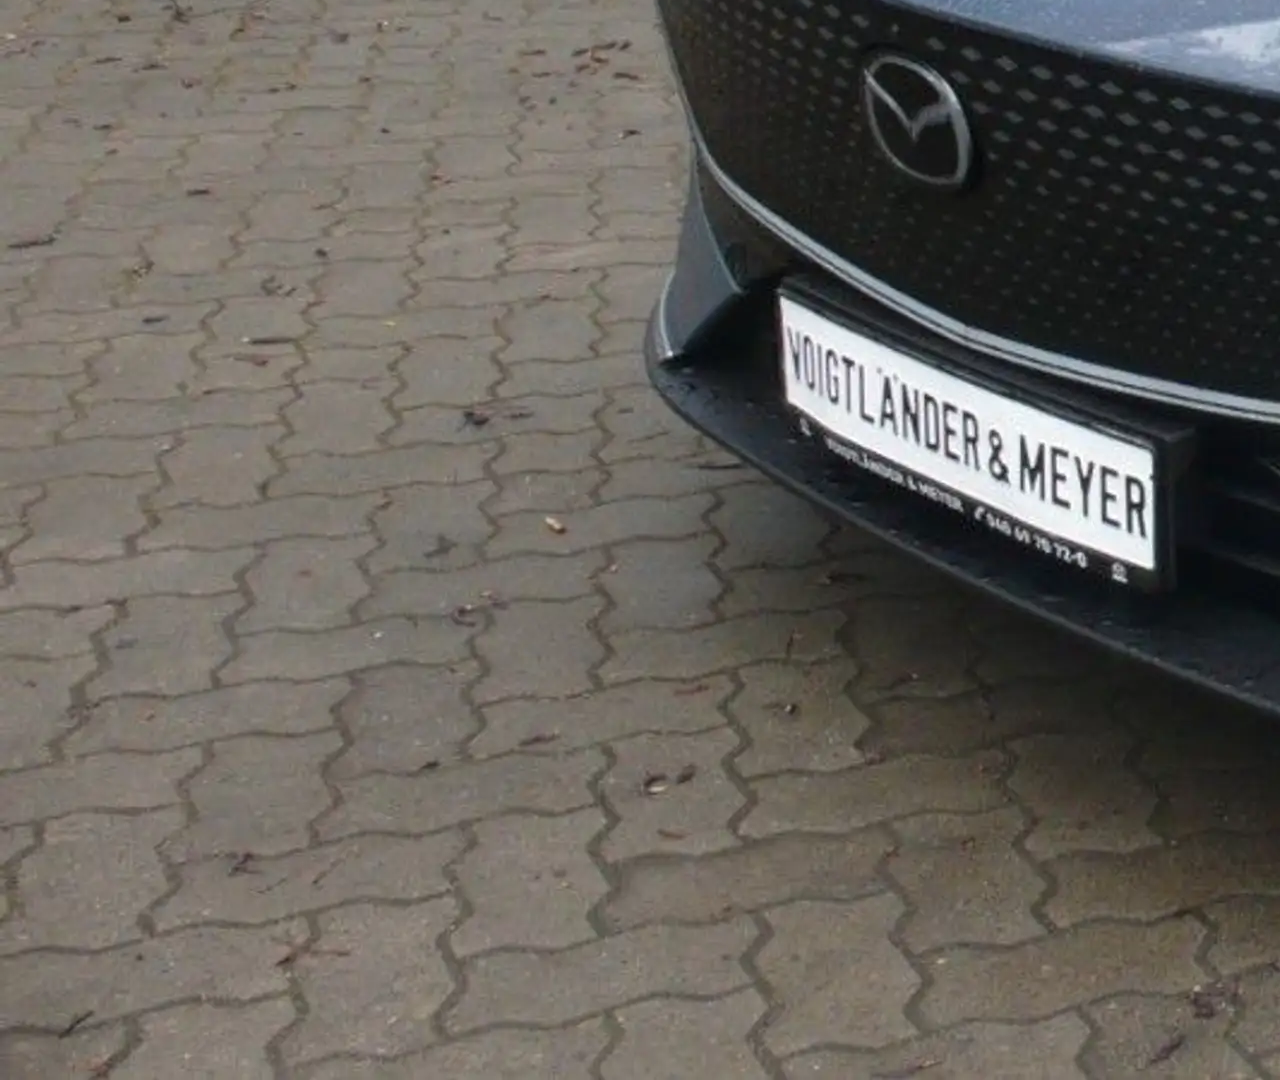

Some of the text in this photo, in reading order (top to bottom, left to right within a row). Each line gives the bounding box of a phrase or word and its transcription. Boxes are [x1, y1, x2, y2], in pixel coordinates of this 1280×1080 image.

[787, 326, 1147, 539] VOIGTLÄNDER & MEYER
